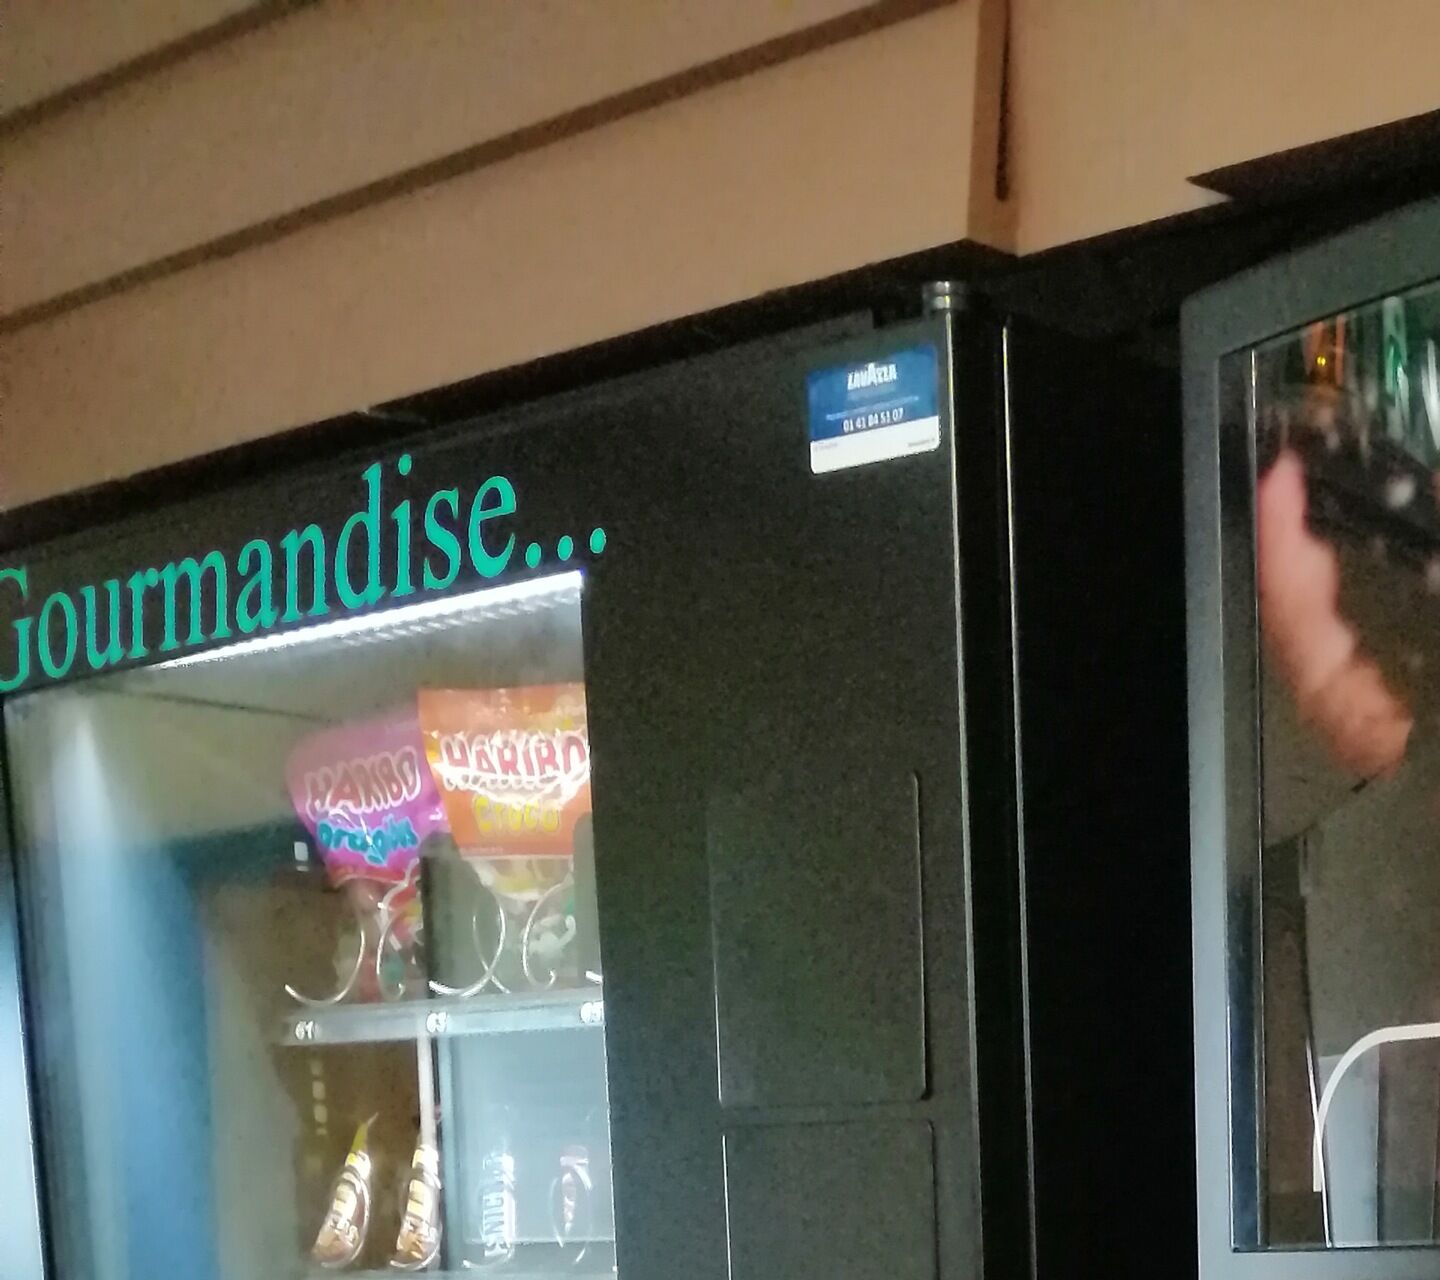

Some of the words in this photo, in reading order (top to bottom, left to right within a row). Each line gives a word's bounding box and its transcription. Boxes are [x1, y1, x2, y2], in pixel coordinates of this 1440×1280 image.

[843, 419, 854, 433] 01
[881, 412, 890, 424] 51
[893, 408, 903, 419] 07
[305, 746, 420, 822] HARIBO
